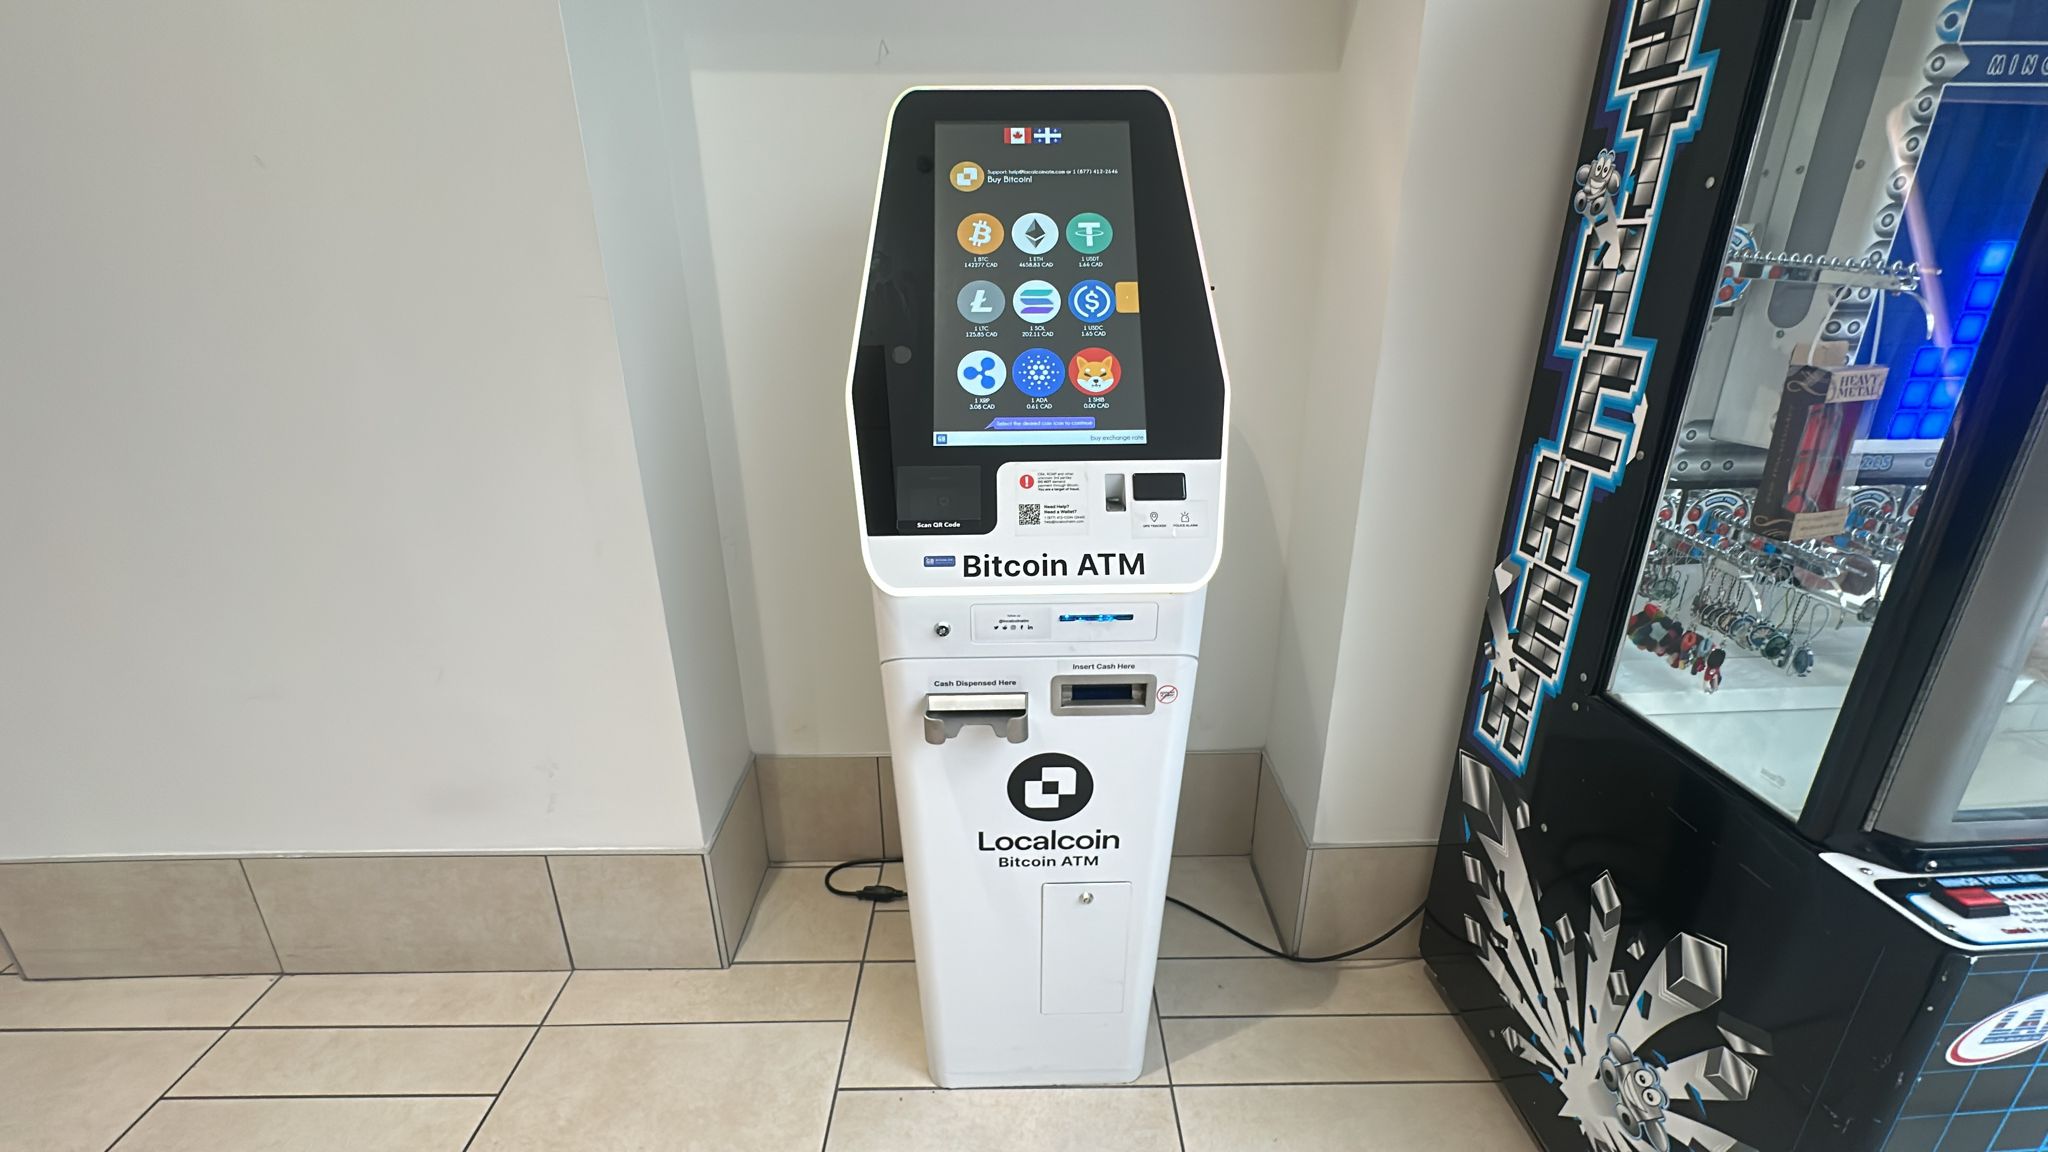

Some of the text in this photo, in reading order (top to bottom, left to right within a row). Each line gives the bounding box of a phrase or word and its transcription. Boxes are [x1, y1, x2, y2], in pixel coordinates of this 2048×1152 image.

[987, 176, 1002, 184] Buy
[1840, 374, 1879, 386] HEAVY
[1839, 386, 1878, 398] METAL
[963, 552, 1145, 578] Bitcoin ATM
[956, 680, 997, 688] Dispensed
[978, 829, 1120, 851] Localcoin
[998, 856, 1099, 867] Bitcoin ATM
